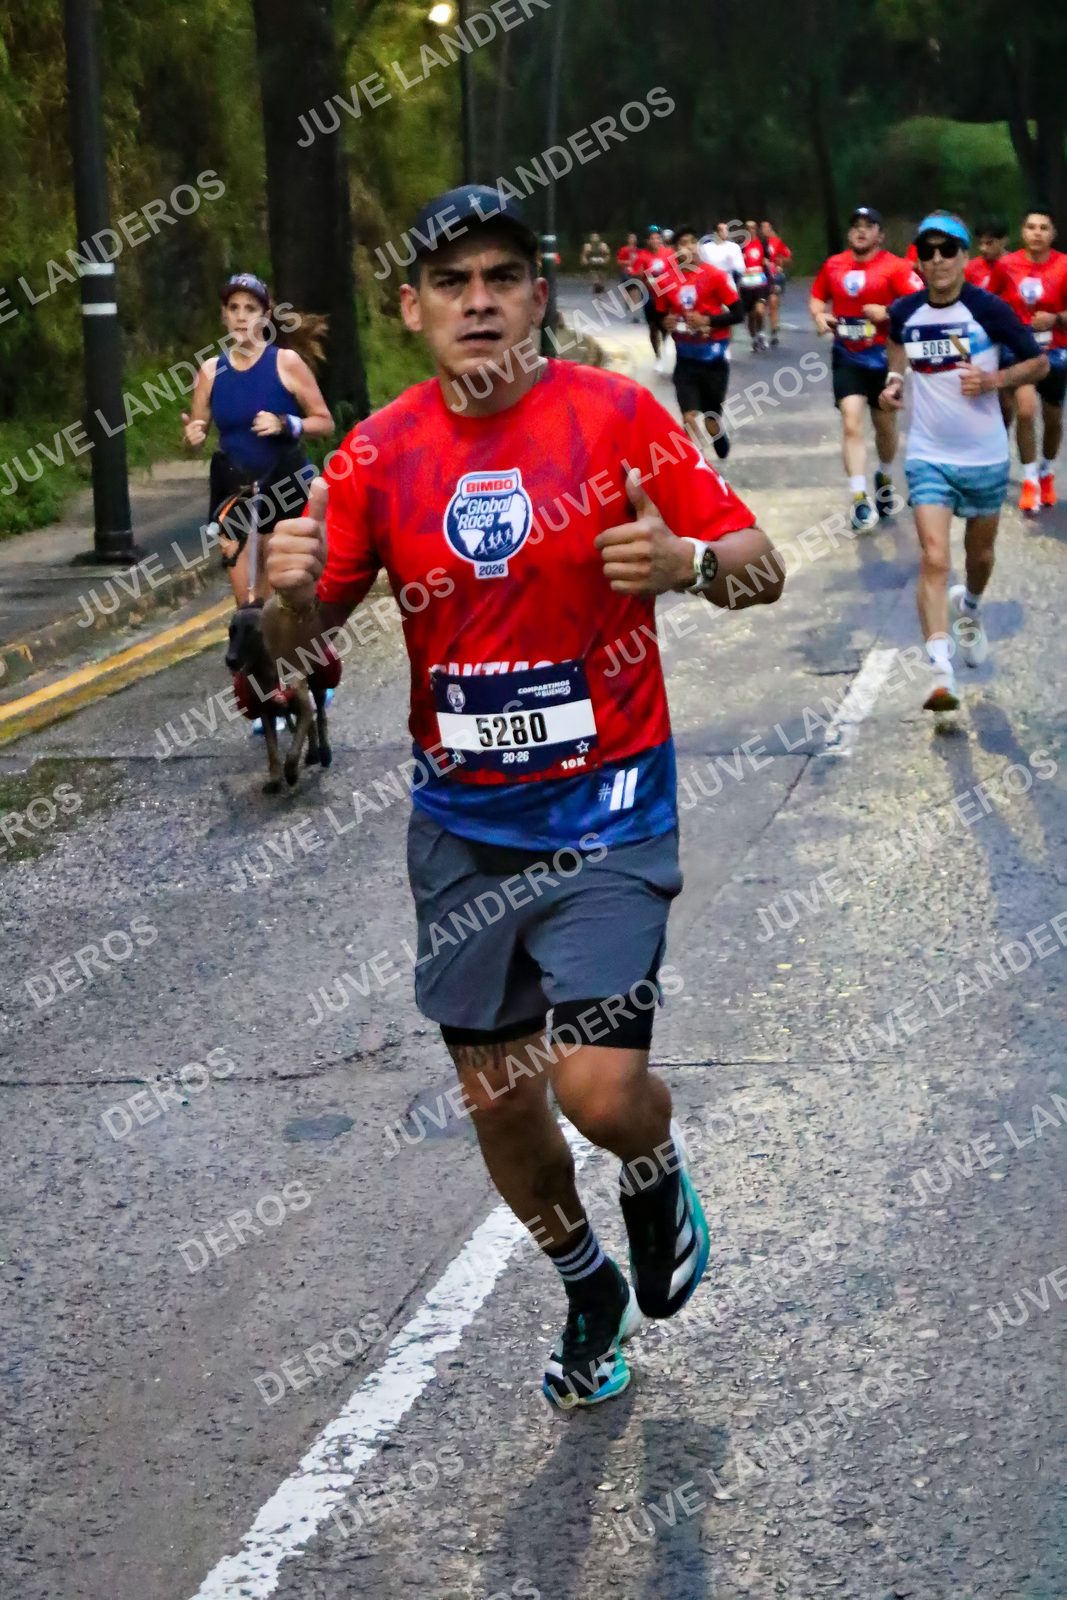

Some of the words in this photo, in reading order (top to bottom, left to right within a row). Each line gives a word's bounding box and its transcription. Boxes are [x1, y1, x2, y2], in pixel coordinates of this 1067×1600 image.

[922, 340, 951, 356] 5063
[466, 480, 513, 492] BIMBO
[467, 496, 513, 515] Global
[458, 514, 494, 530] Race
[478, 564, 505, 576] 2026
[476, 712, 548, 748] 5280
[561, 756, 586, 770] 10K
